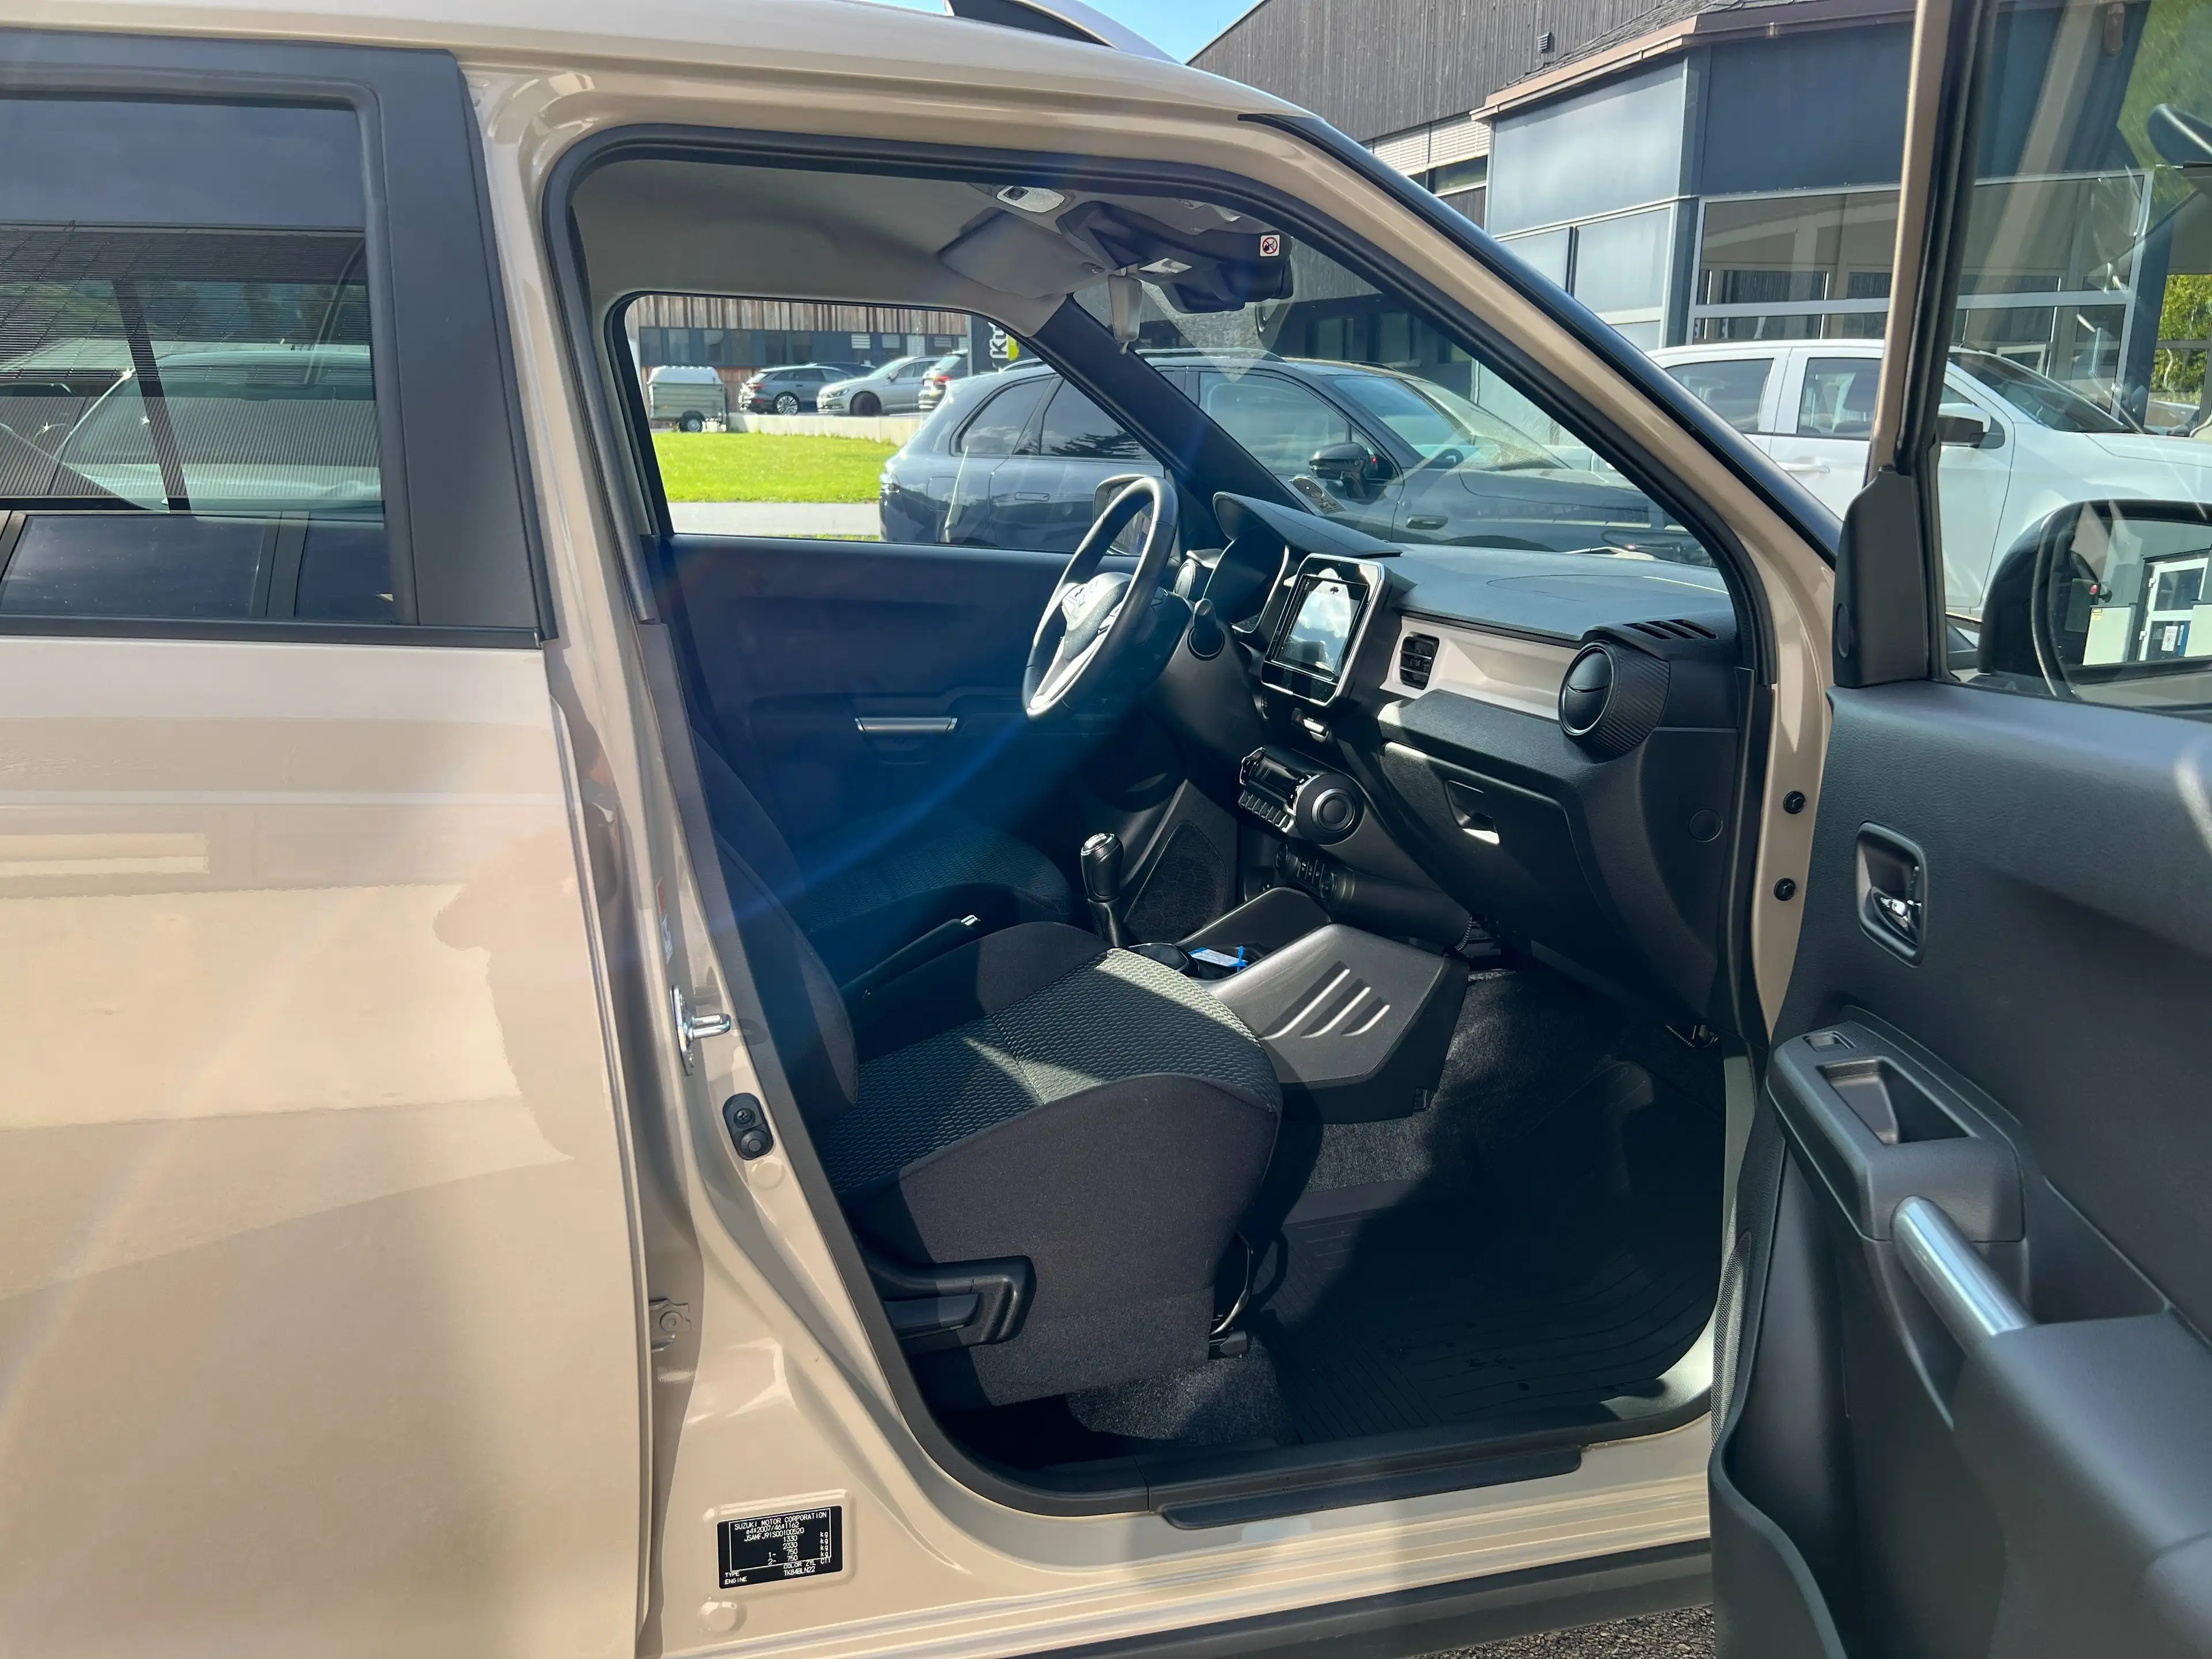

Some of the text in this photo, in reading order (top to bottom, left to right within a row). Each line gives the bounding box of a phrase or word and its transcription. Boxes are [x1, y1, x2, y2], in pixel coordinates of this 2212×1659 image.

[988, 324, 1008, 358] Ku
[734, 1511, 827, 1530] SUZUKI MOTOR CORPORATION
[725, 1575, 747, 1585] ENGINE
